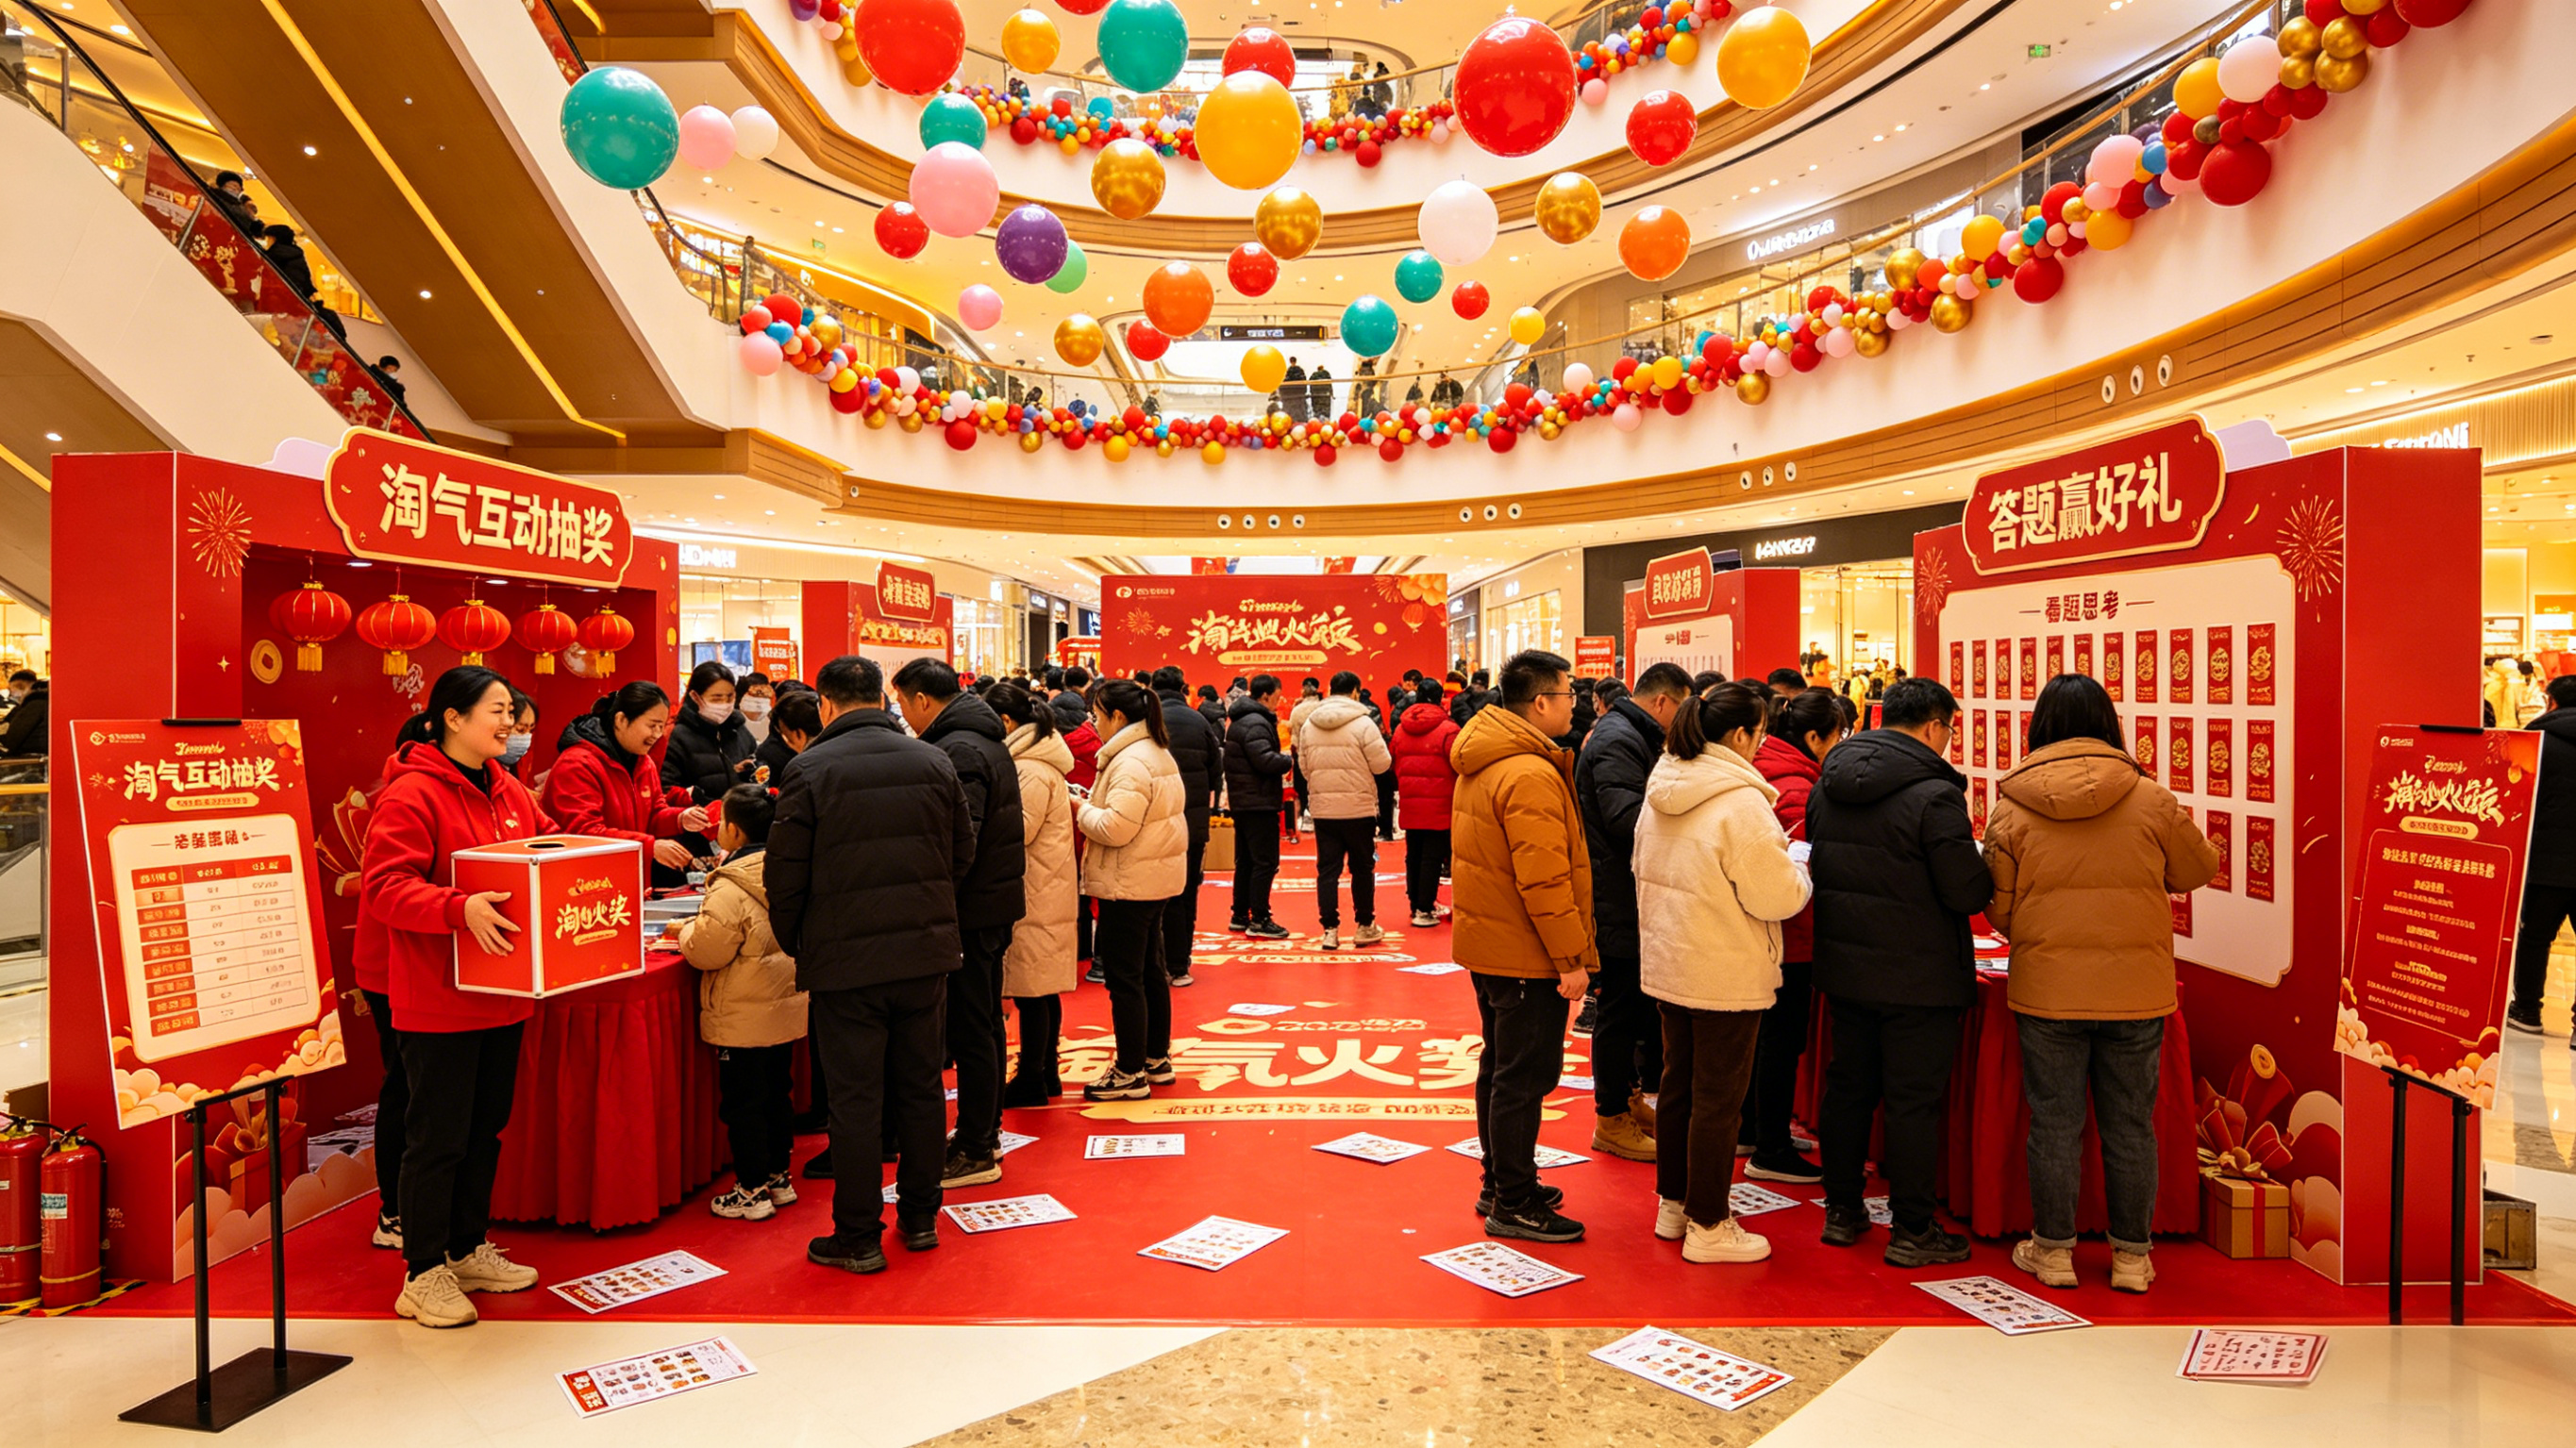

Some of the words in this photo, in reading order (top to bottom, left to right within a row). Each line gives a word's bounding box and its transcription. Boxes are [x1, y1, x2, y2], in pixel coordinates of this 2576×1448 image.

[378, 462, 614, 567] 淘气互动抽奖
[1988, 451, 2183, 554] 答题赢好礼
